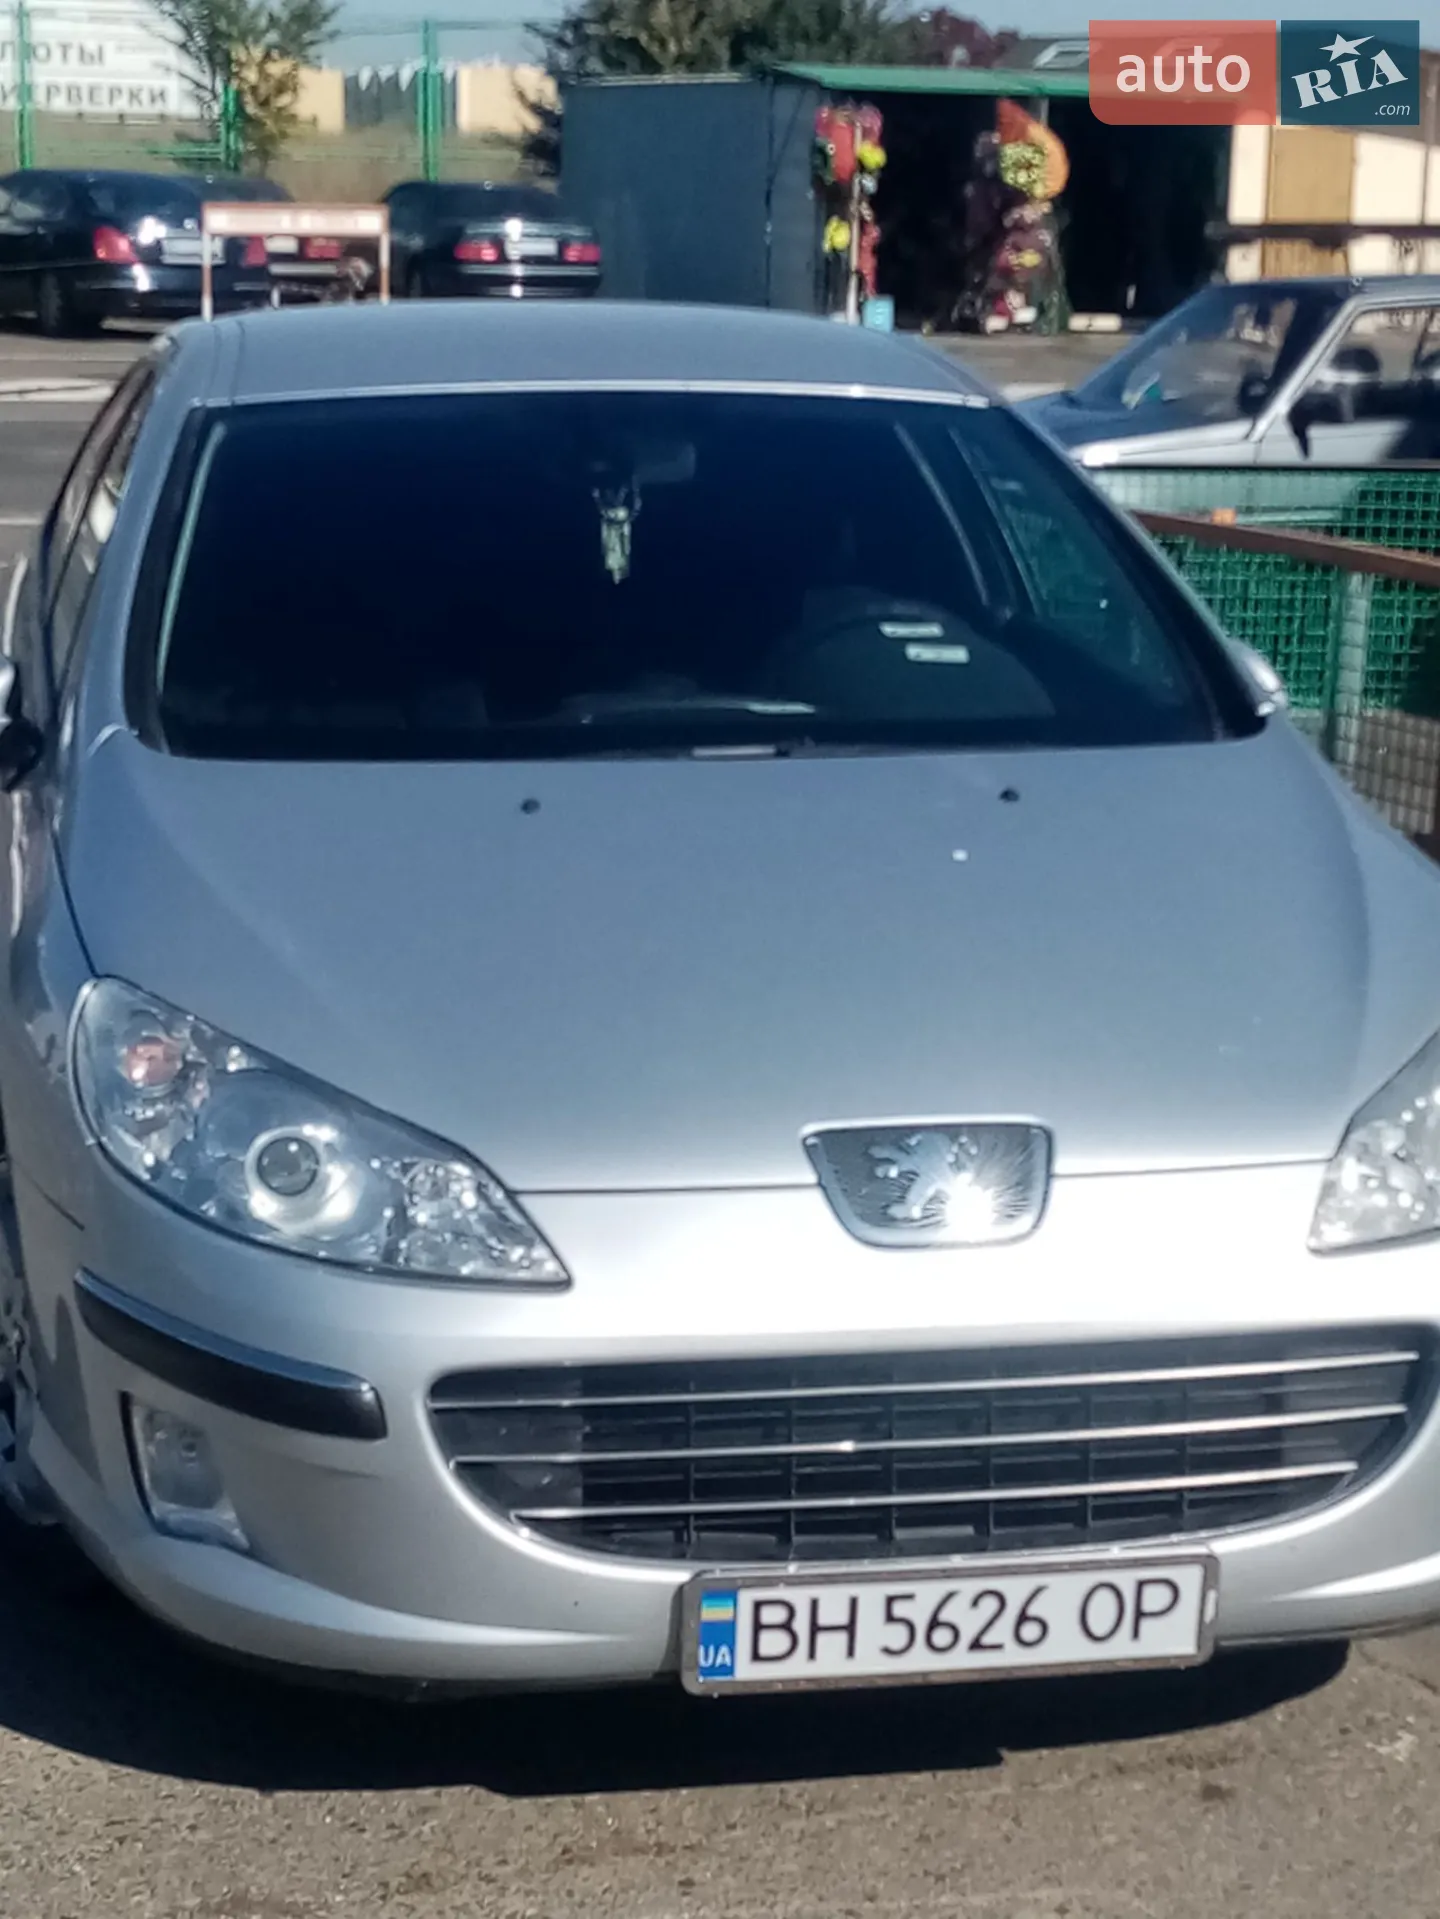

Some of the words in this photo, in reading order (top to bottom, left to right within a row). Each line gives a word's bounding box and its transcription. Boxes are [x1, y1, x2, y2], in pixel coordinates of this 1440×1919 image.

[750, 1595, 859, 1663] BH
[880, 1585, 1050, 1658] 5626
[1079, 1577, 1181, 1645] OP
[698, 1644, 732, 1669] UA
